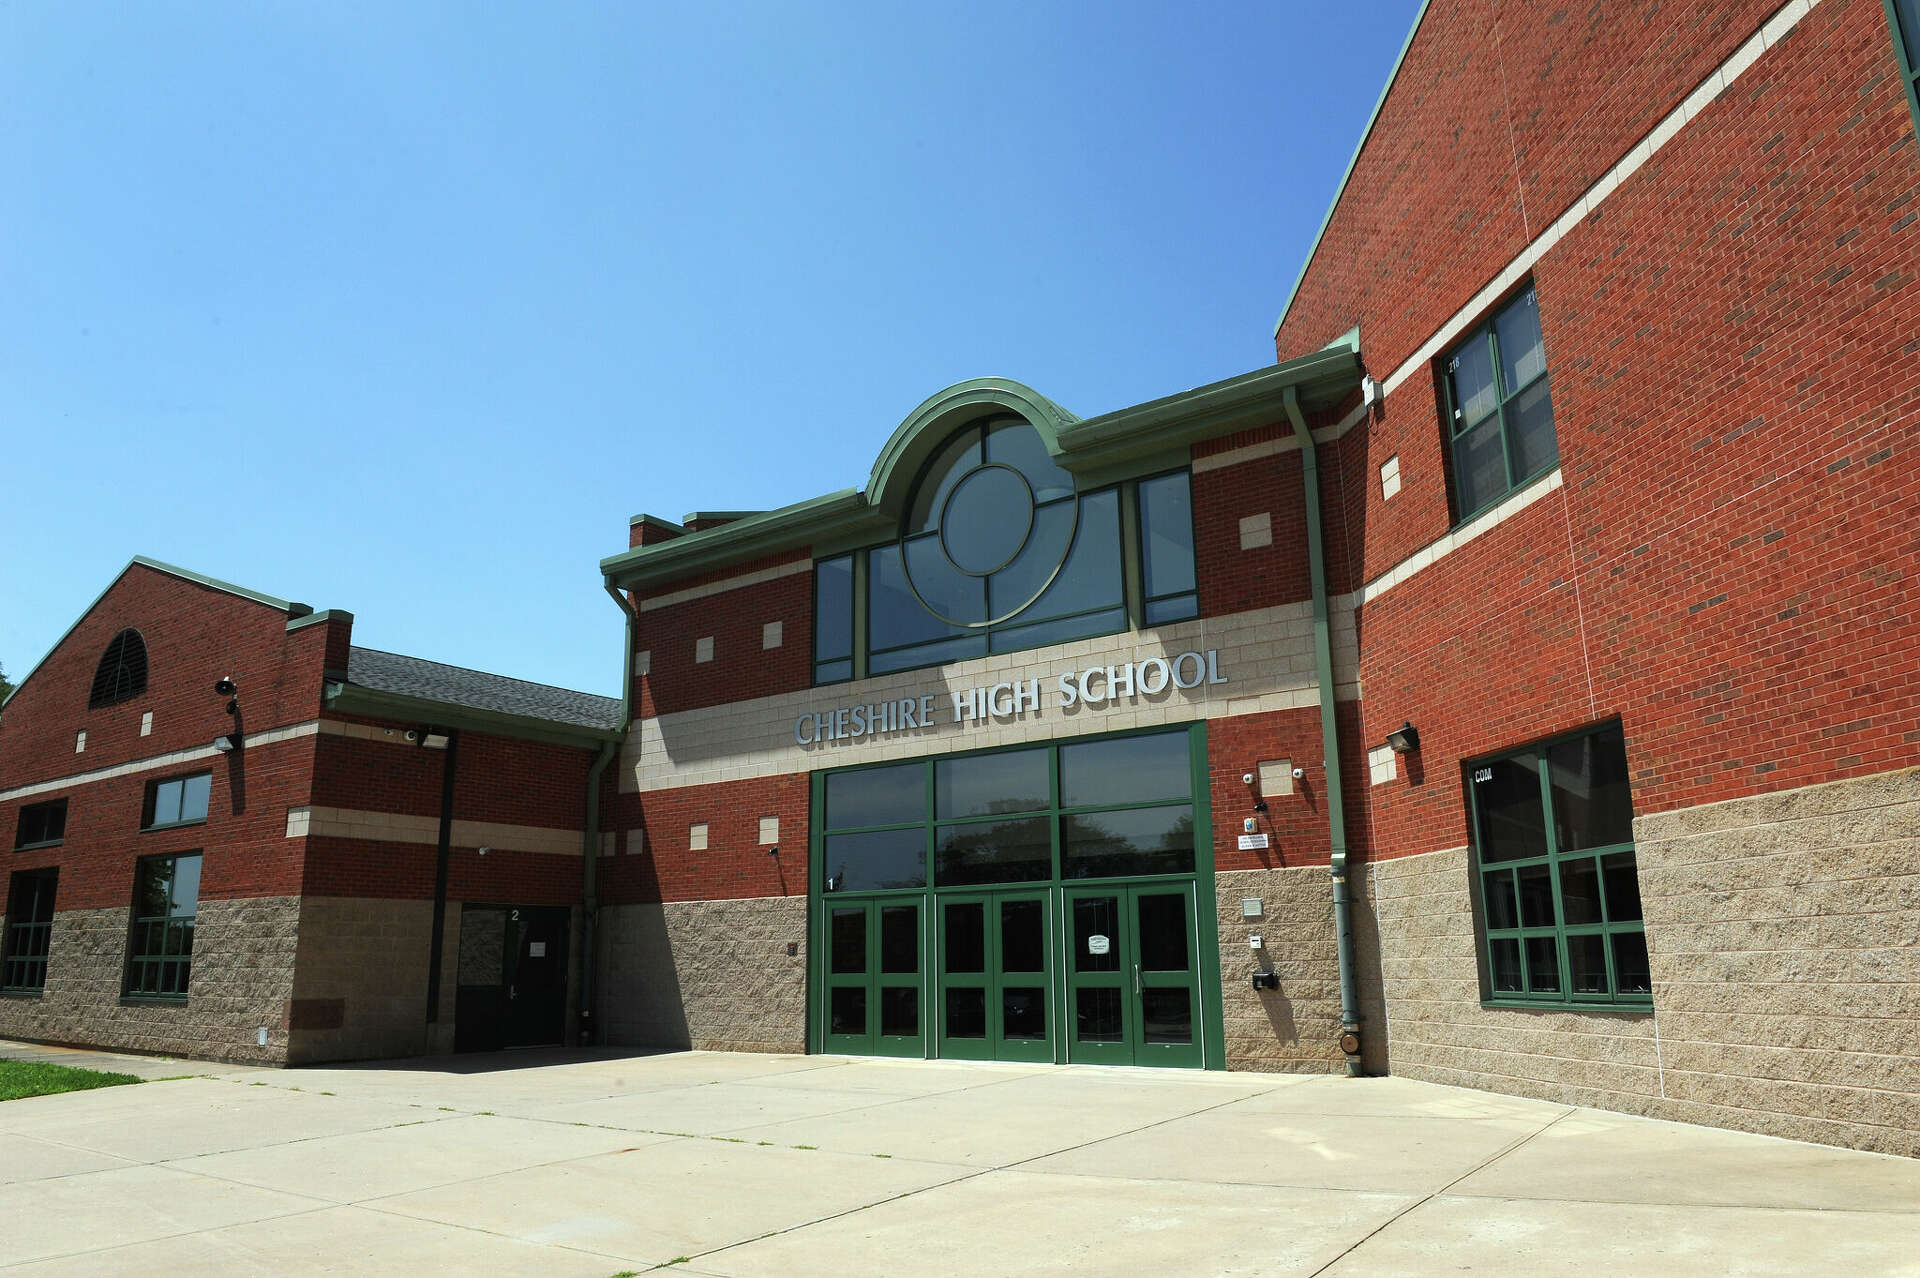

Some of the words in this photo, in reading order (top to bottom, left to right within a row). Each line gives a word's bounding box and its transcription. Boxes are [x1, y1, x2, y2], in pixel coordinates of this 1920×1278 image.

[794, 695, 936, 745] CHESHIRE
[953, 678, 1040, 722] HIGH
[1058, 649, 1229, 707] SCHOOL
[1475, 767, 1492, 783] COM
[828, 877, 834, 890] 1
[511, 910, 519, 921] 2
